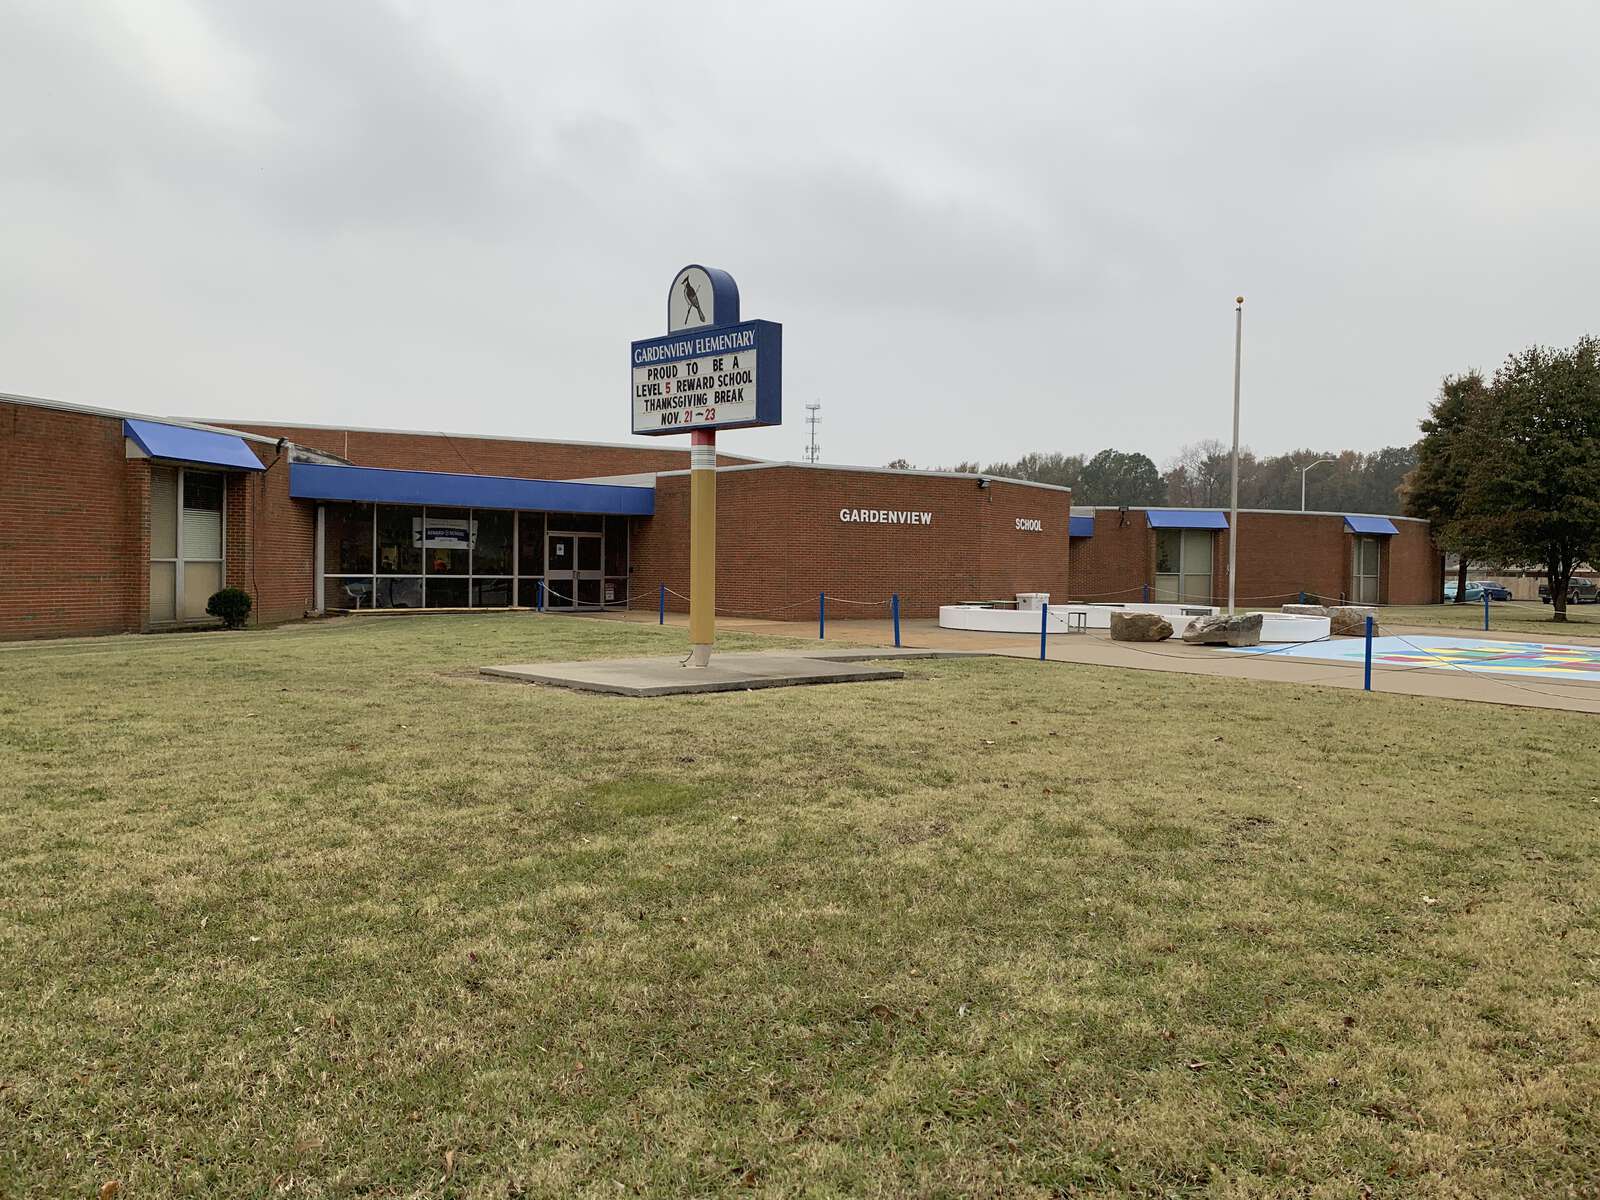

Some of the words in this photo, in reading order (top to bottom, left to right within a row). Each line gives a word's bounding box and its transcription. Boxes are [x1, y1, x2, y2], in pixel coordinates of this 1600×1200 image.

[634, 342, 694, 363] GARDENVIEW
[696, 330, 755, 354] ELEMENTARY
[647, 364, 678, 381] PROUD
[686, 361, 698, 376] TO
[713, 358, 723, 372] BE
[733, 355, 739, 369] A
[636, 382, 662, 398] LEVEL
[665, 381, 671, 394] 5
[676, 375, 715, 393] REWARD
[717, 370, 752, 388] SCHOOL
[643, 393, 708, 412] THANKSGIVING
[714, 387, 744, 404] BREAK
[661, 411, 682, 426] NOV.
[839, 508, 932, 525] GARDENVIEW
[1015, 518, 1043, 532] SCHOOL
